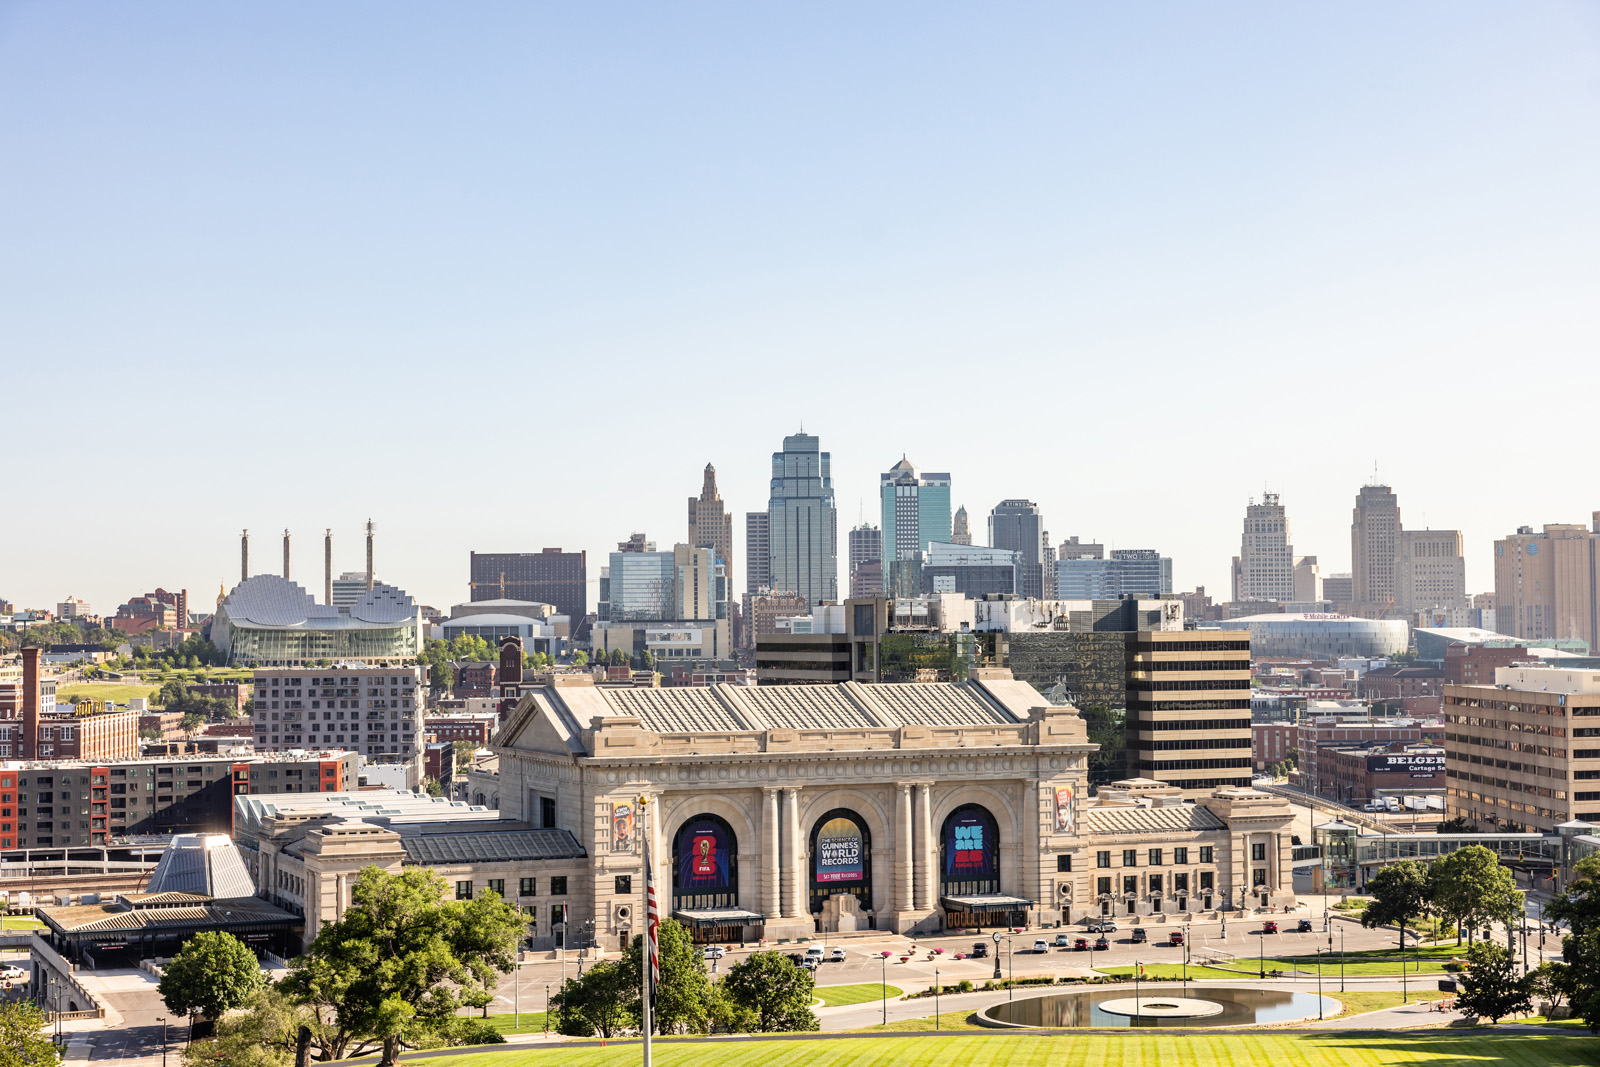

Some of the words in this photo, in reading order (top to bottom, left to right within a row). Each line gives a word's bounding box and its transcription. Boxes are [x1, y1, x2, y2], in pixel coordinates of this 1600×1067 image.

[1387, 756, 1445, 764] BELGER
[955, 825, 983, 840] WE
[821, 842, 859, 850] GUINNESS
[821, 857, 859, 866] RECORDS
